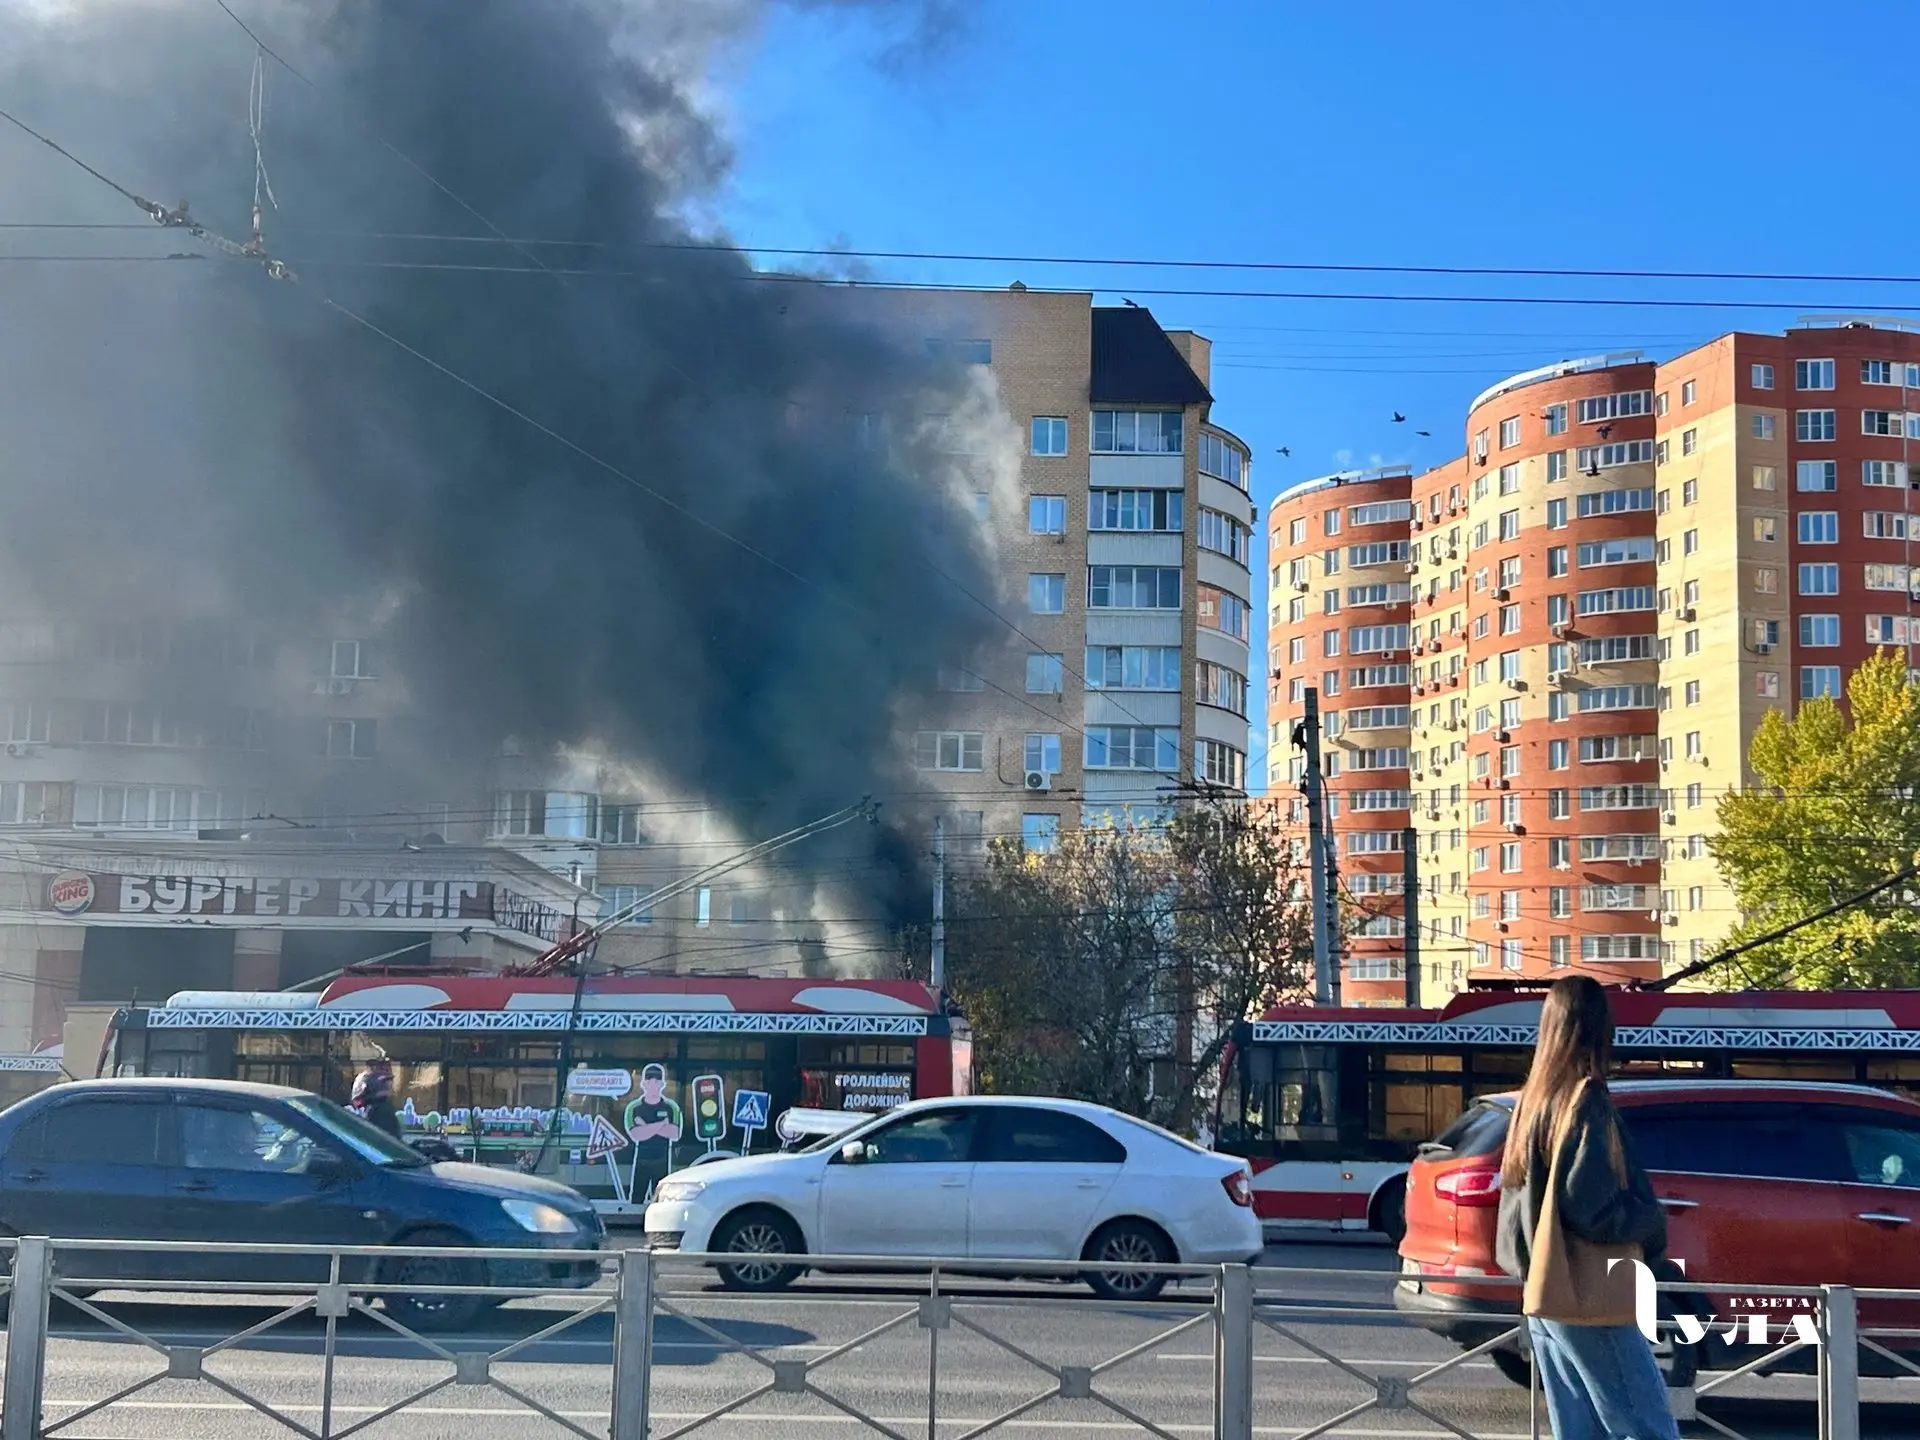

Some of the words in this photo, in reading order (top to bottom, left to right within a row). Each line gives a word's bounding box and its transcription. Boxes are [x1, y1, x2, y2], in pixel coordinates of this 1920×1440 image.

[52, 877, 88, 892] BURGER
[52, 886, 88, 905] KING
[119, 874, 320, 915] БУРГЕР
[338, 878, 478, 919] КИНГ
[835, 1072, 911, 1089] ТРОЛЛЕЙБУС
[843, 1092, 910, 1109] ДОРОЖНОЙ
